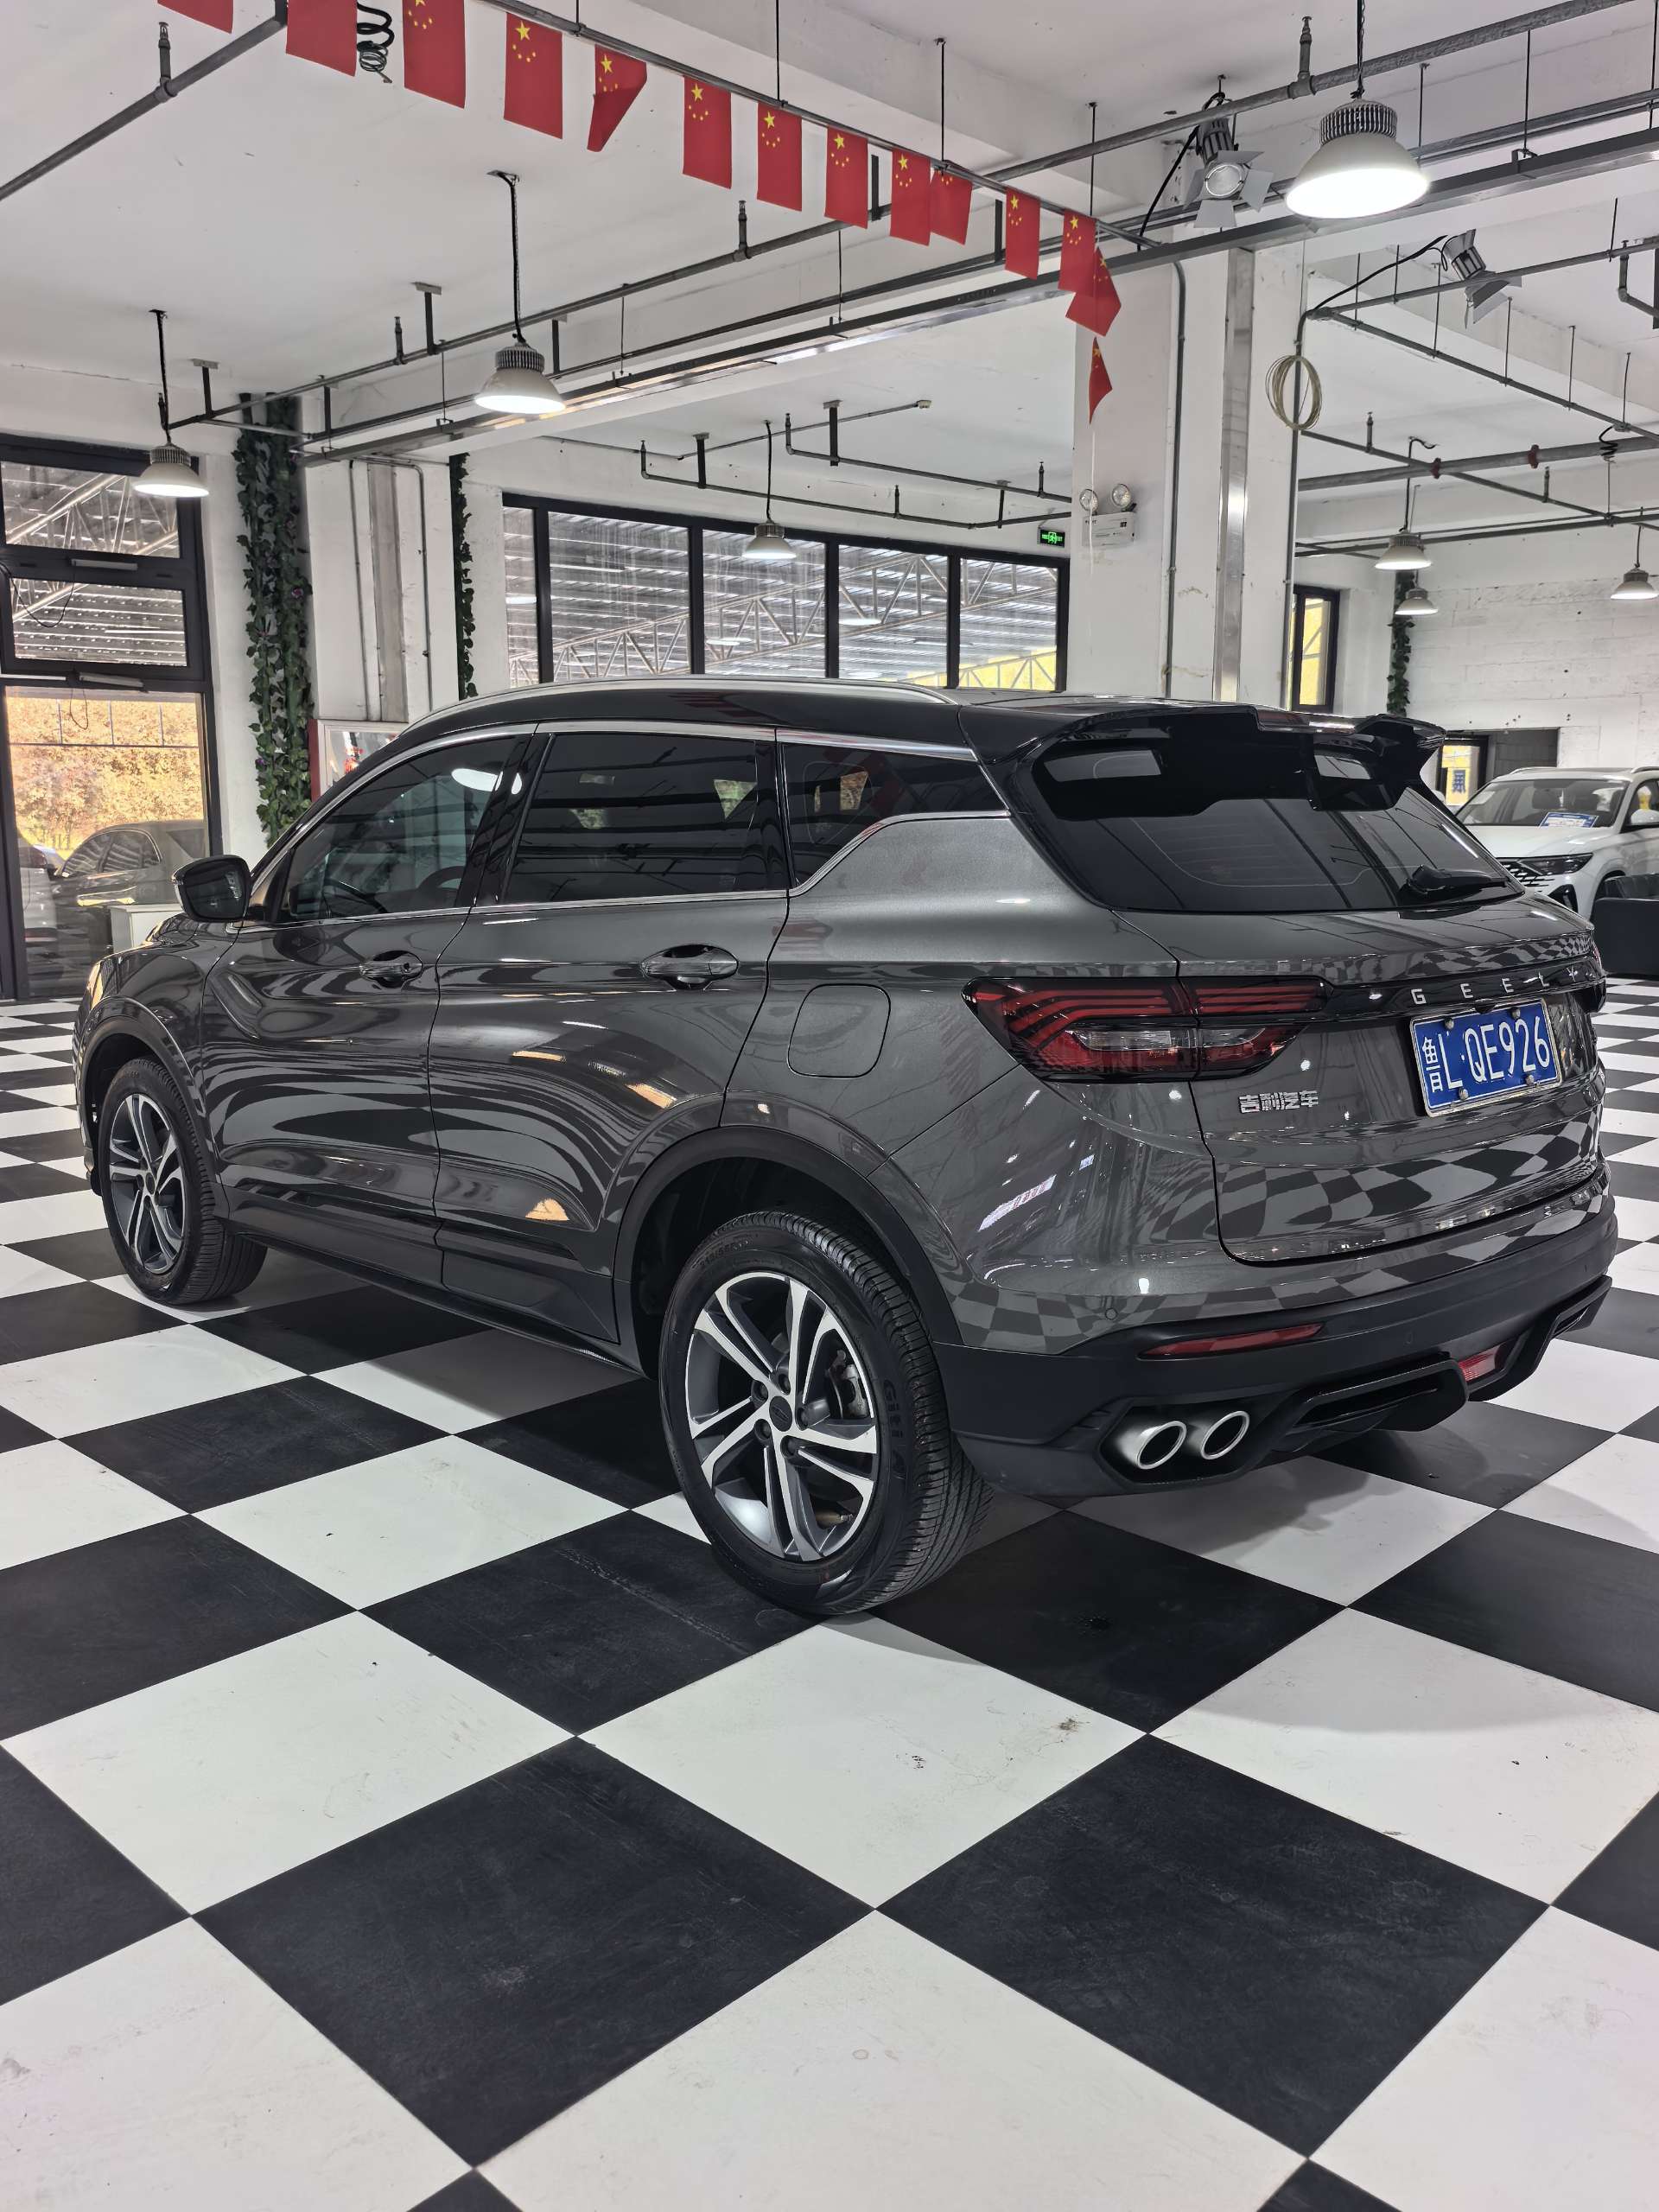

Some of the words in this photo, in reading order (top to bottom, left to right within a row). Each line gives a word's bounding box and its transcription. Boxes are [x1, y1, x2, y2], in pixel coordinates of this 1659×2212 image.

[1411, 965, 1578, 1005] GEELY
[1239, 1090, 1319, 1114] 吉利汽车
